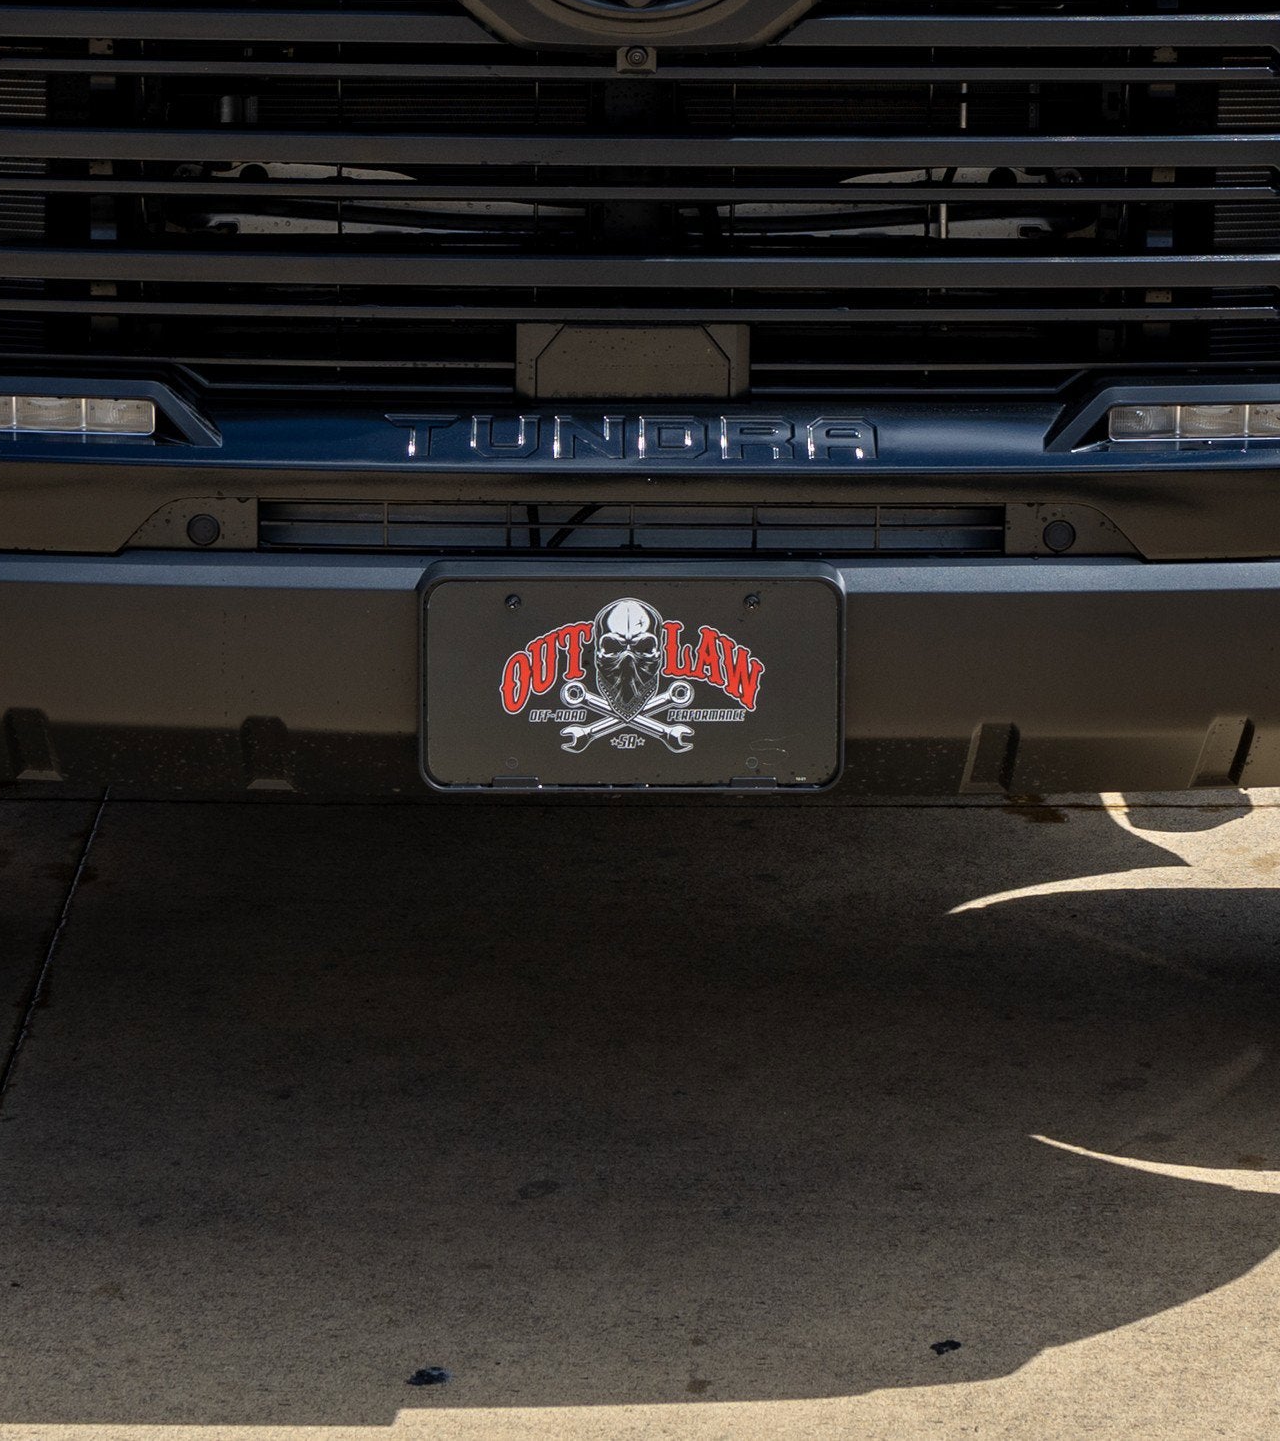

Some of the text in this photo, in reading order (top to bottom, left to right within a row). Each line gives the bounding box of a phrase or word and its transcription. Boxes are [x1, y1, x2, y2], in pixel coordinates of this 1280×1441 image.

[384, 413, 879, 459] TUNDRA
[529, 709, 746, 723] OFF-ROAD PERFORMANCE
